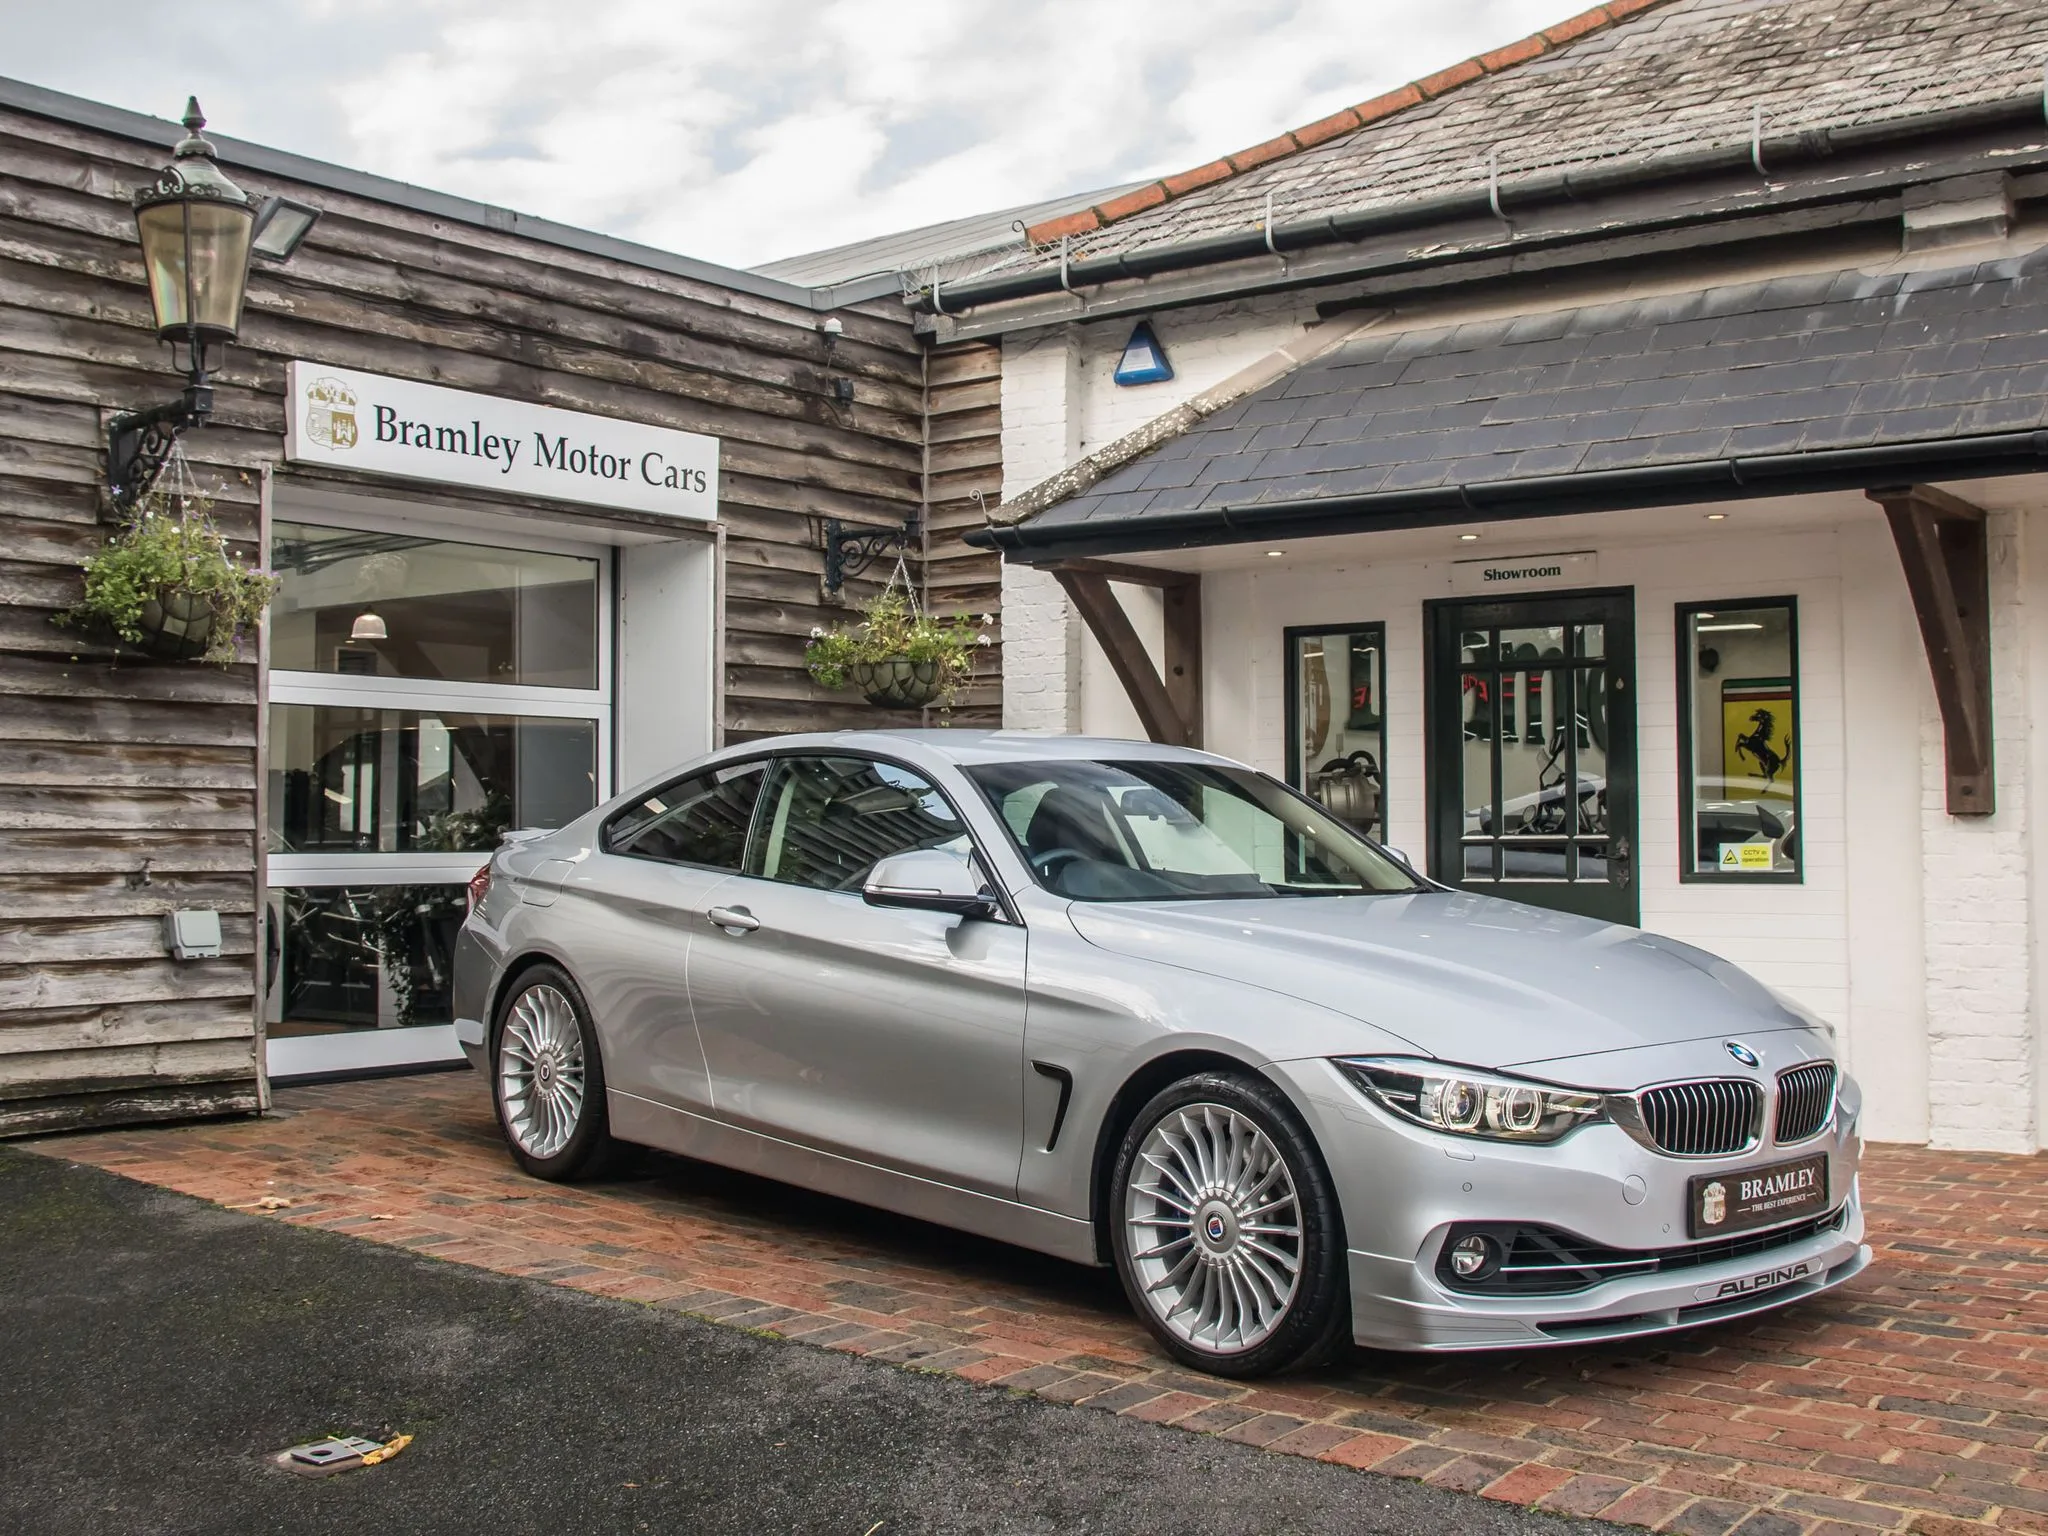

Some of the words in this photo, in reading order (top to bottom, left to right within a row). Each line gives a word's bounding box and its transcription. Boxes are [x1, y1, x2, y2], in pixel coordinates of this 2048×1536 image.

[373, 404, 520, 473] Bramley
[533, 432, 631, 480] Motor
[640, 451, 707, 494] Cars
[1483, 566, 1561, 581] Showroom
[1740, 1167, 1815, 1201] BRAMLEY
[1751, 1202, 1763, 1213] THE
[1763, 1200, 1777, 1210] BEST
[1777, 1193, 1806, 1206] EXPERIENCE
[1716, 1263, 1809, 1298] ALPINA
